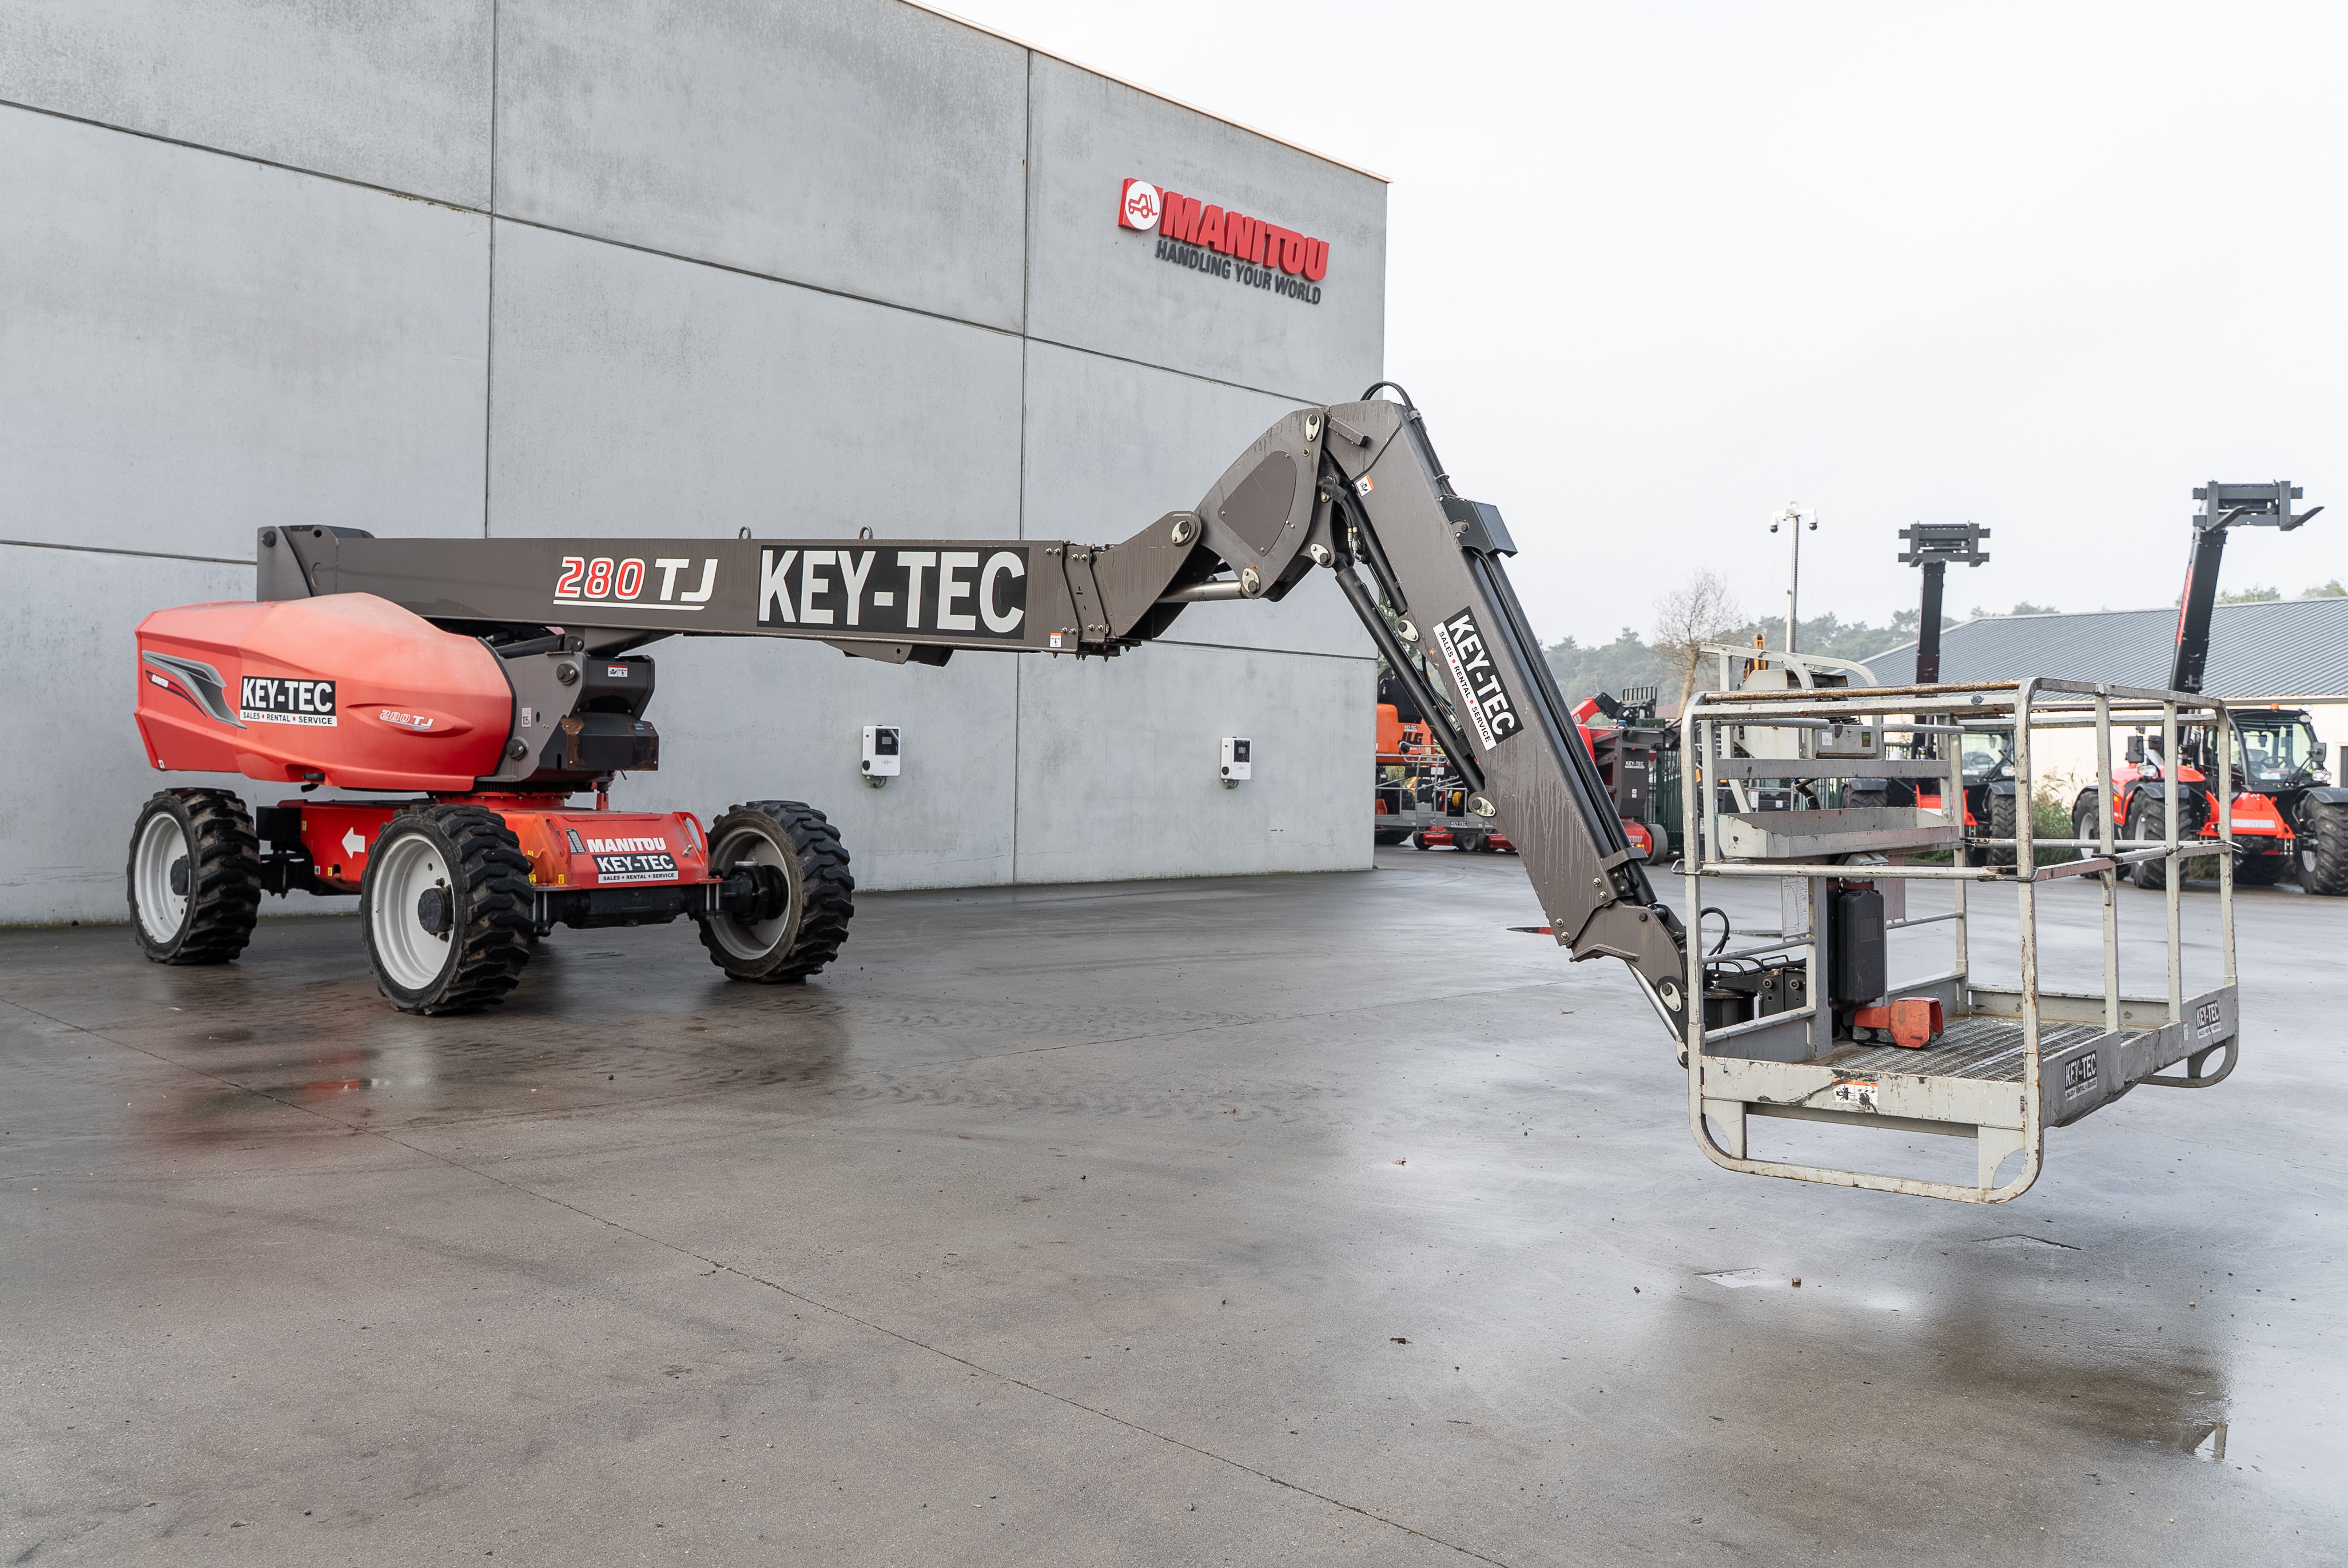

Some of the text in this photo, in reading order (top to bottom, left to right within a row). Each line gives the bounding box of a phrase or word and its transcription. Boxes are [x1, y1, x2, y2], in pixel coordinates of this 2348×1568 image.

[1159, 190, 1330, 282] MANITOU
[1155, 239, 1322, 305] HANDLING YOUR WORLD
[554, 556, 719, 602] 280 TJ
[758, 550, 1025, 633] KEY-TEC
[1439, 631, 1491, 742] SALES RENTAL SERVICE
[1447, 614, 1515, 735] KEY-TEC
[242, 678, 333, 713] KEY-TEC
[243, 711, 333, 725] SALES RENTAL SERVICE
[379, 709, 434, 727] 280 TJ
[1398, 731, 1423, 745] JLG
[586, 837, 667, 853] MANITOU
[596, 855, 674, 872] KEY-TEC
[2196, 1002, 2219, 1028] KEY-TEC
